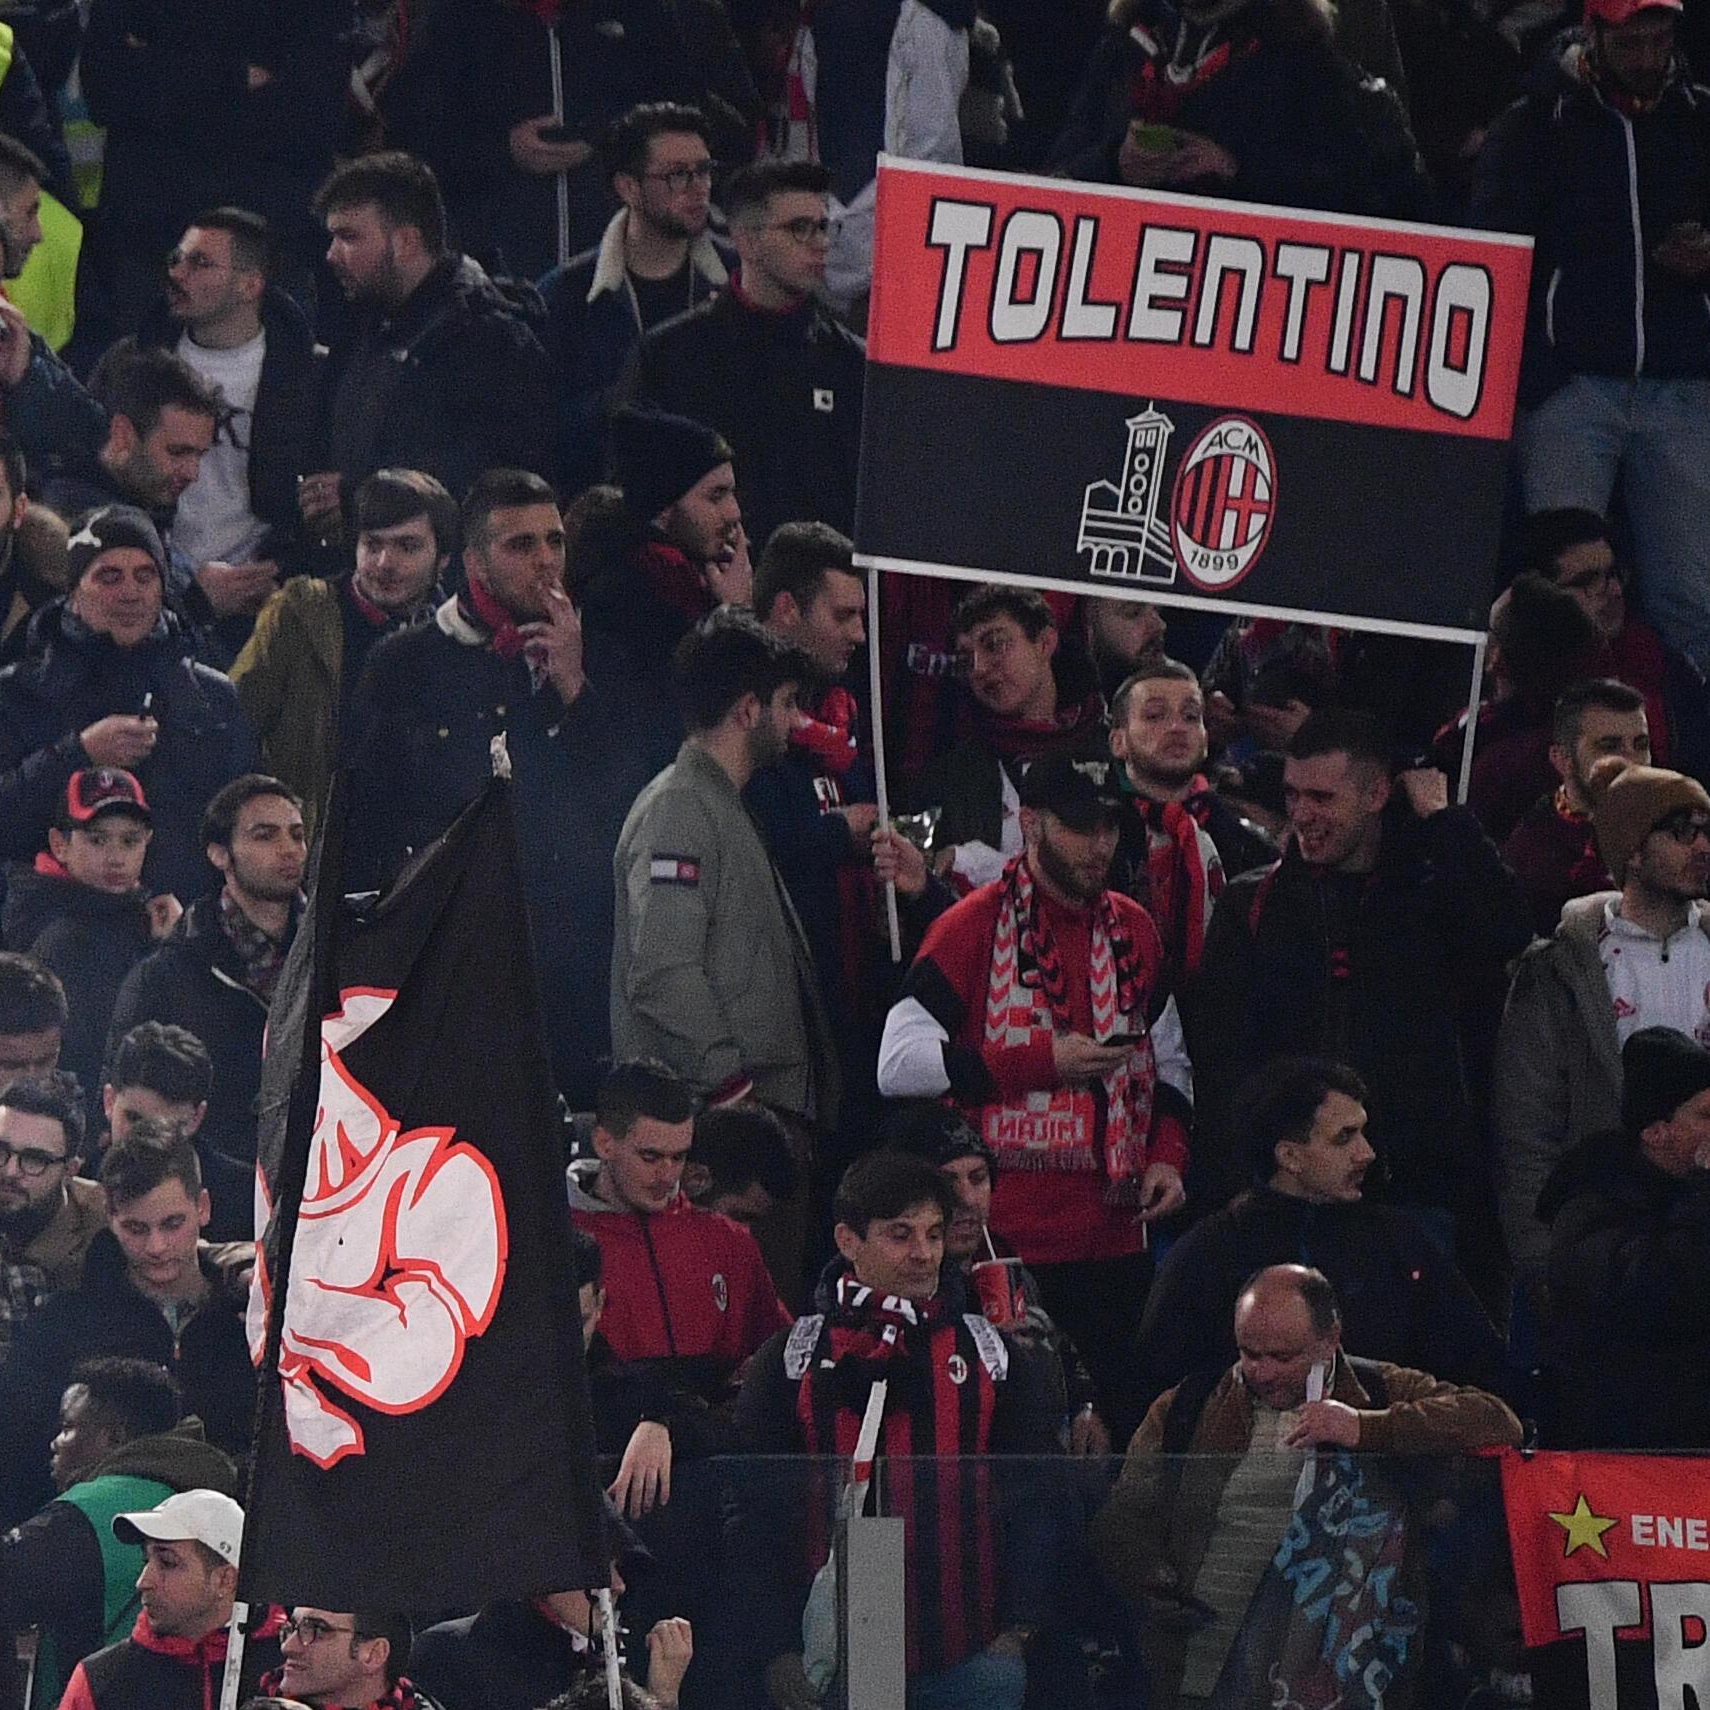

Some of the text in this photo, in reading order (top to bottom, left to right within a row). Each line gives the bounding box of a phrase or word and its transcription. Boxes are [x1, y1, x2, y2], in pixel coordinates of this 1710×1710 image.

[927, 199, 1494, 419] TOLENTINO
[1202, 427, 1261, 462] ACM
[1191, 550, 1239, 571] 1899
